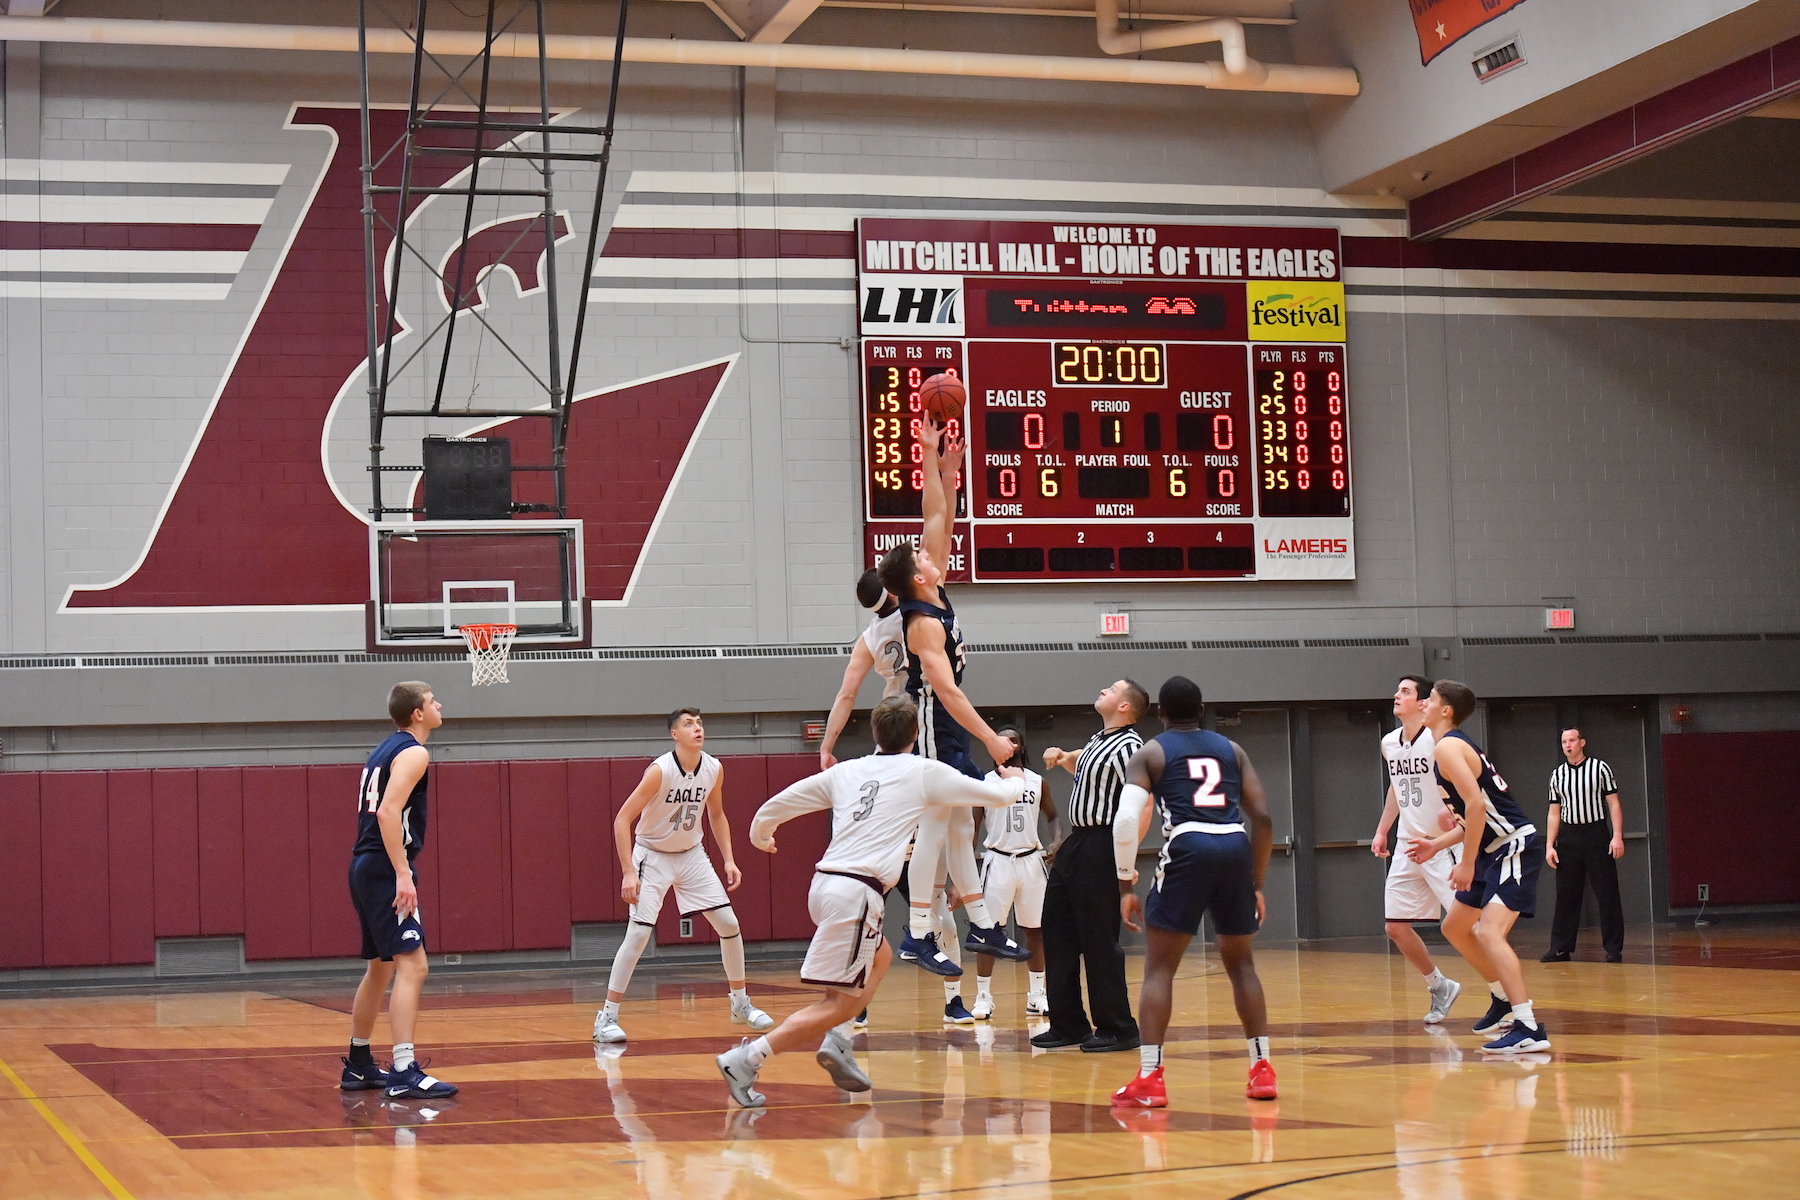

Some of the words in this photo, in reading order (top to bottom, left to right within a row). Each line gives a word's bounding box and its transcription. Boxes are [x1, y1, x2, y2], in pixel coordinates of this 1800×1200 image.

[1053, 226, 1131, 244] WELCOME
[1136, 228, 1156, 244] TO
[866, 240, 993, 272] MITCHELL
[999, 243, 1060, 273] HALL
[1081, 245, 1154, 275] HOME
[1159, 246, 1190, 275] OF
[1195, 247, 1242, 276] THE
[1247, 248, 1336, 279] EAGLES
[1251, 300, 1340, 327] festival
[873, 346, 897, 358] PLYR
[906, 347, 922, 359] FLS
[935, 347, 953, 359] PTS
[1260, 351, 1282, 362] PLYR
[1291, 351, 1307, 363] FLS
[1318, 351, 1335, 363] PTS
[1060, 345, 1160, 382] 20:00
[888, 367, 899, 388] 3
[908, 367, 921, 388] 0
[1272, 371, 1285, 391] 2
[1293, 371, 1306, 391] 0
[1328, 371, 1340, 391] 0
[879, 392, 900, 412] 15
[909, 392, 922, 412] 0
[985, 389, 1047, 408] EAGLES
[1091, 400, 1131, 412] PERIOD
[1180, 391, 1232, 409] GUEST
[1260, 395, 1286, 415] 25
[1294, 395, 1307, 415] 0
[1329, 395, 1341, 415] 0
[873, 418, 900, 439] 23
[947, 418, 960, 439] 0
[1023, 413, 1044, 449] 0
[1114, 419, 1120, 444] 1
[1213, 414, 1233, 449] 0
[1262, 420, 1287, 440] 33
[1295, 420, 1308, 440] 0
[1330, 420, 1342, 440] 0
[876, 443, 901, 464] 35
[911, 442, 923, 464] 0
[985, 454, 1021, 467] FOULS
[1035, 455, 1066, 467] T.O.L.
[1075, 455, 1117, 467] PLAYER
[1123, 455, 1151, 467] FOUL
[1162, 455, 1193, 467] T.O.L.
[1204, 455, 1239, 467] FOULS
[1263, 444, 1288, 464] 34
[1296, 444, 1309, 464] 0
[1331, 444, 1343, 464] 0
[874, 469, 902, 490] 45
[912, 469, 924, 490] 0
[1000, 468, 1016, 497] 0
[1041, 468, 1058, 497] 6
[1169, 469, 1186, 497] 6
[1218, 469, 1235, 497] 0
[1265, 469, 1289, 490] 35
[1297, 469, 1310, 490] 0
[1332, 469, 1344, 490] 0
[986, 504, 1023, 516] SCORE
[1095, 504, 1134, 516] MATCH
[1206, 504, 1241, 516] SCORE
[1006, 532, 1013, 544] 1
[1077, 531, 1085, 544] 2
[1147, 531, 1154, 543] 3
[1215, 531, 1223, 543] 4
[1264, 539, 1347, 553] LAMERS
[1105, 616, 1126, 632] EXIT
[1552, 610, 1571, 627] EXIT
[1389, 757, 1429, 776] EAGLES
[1187, 757, 1226, 807] 2
[853, 780, 879, 821] 3
[1398, 777, 1423, 808] 35
[670, 805, 698, 831] 45
[1006, 806, 1025, 833] 15
